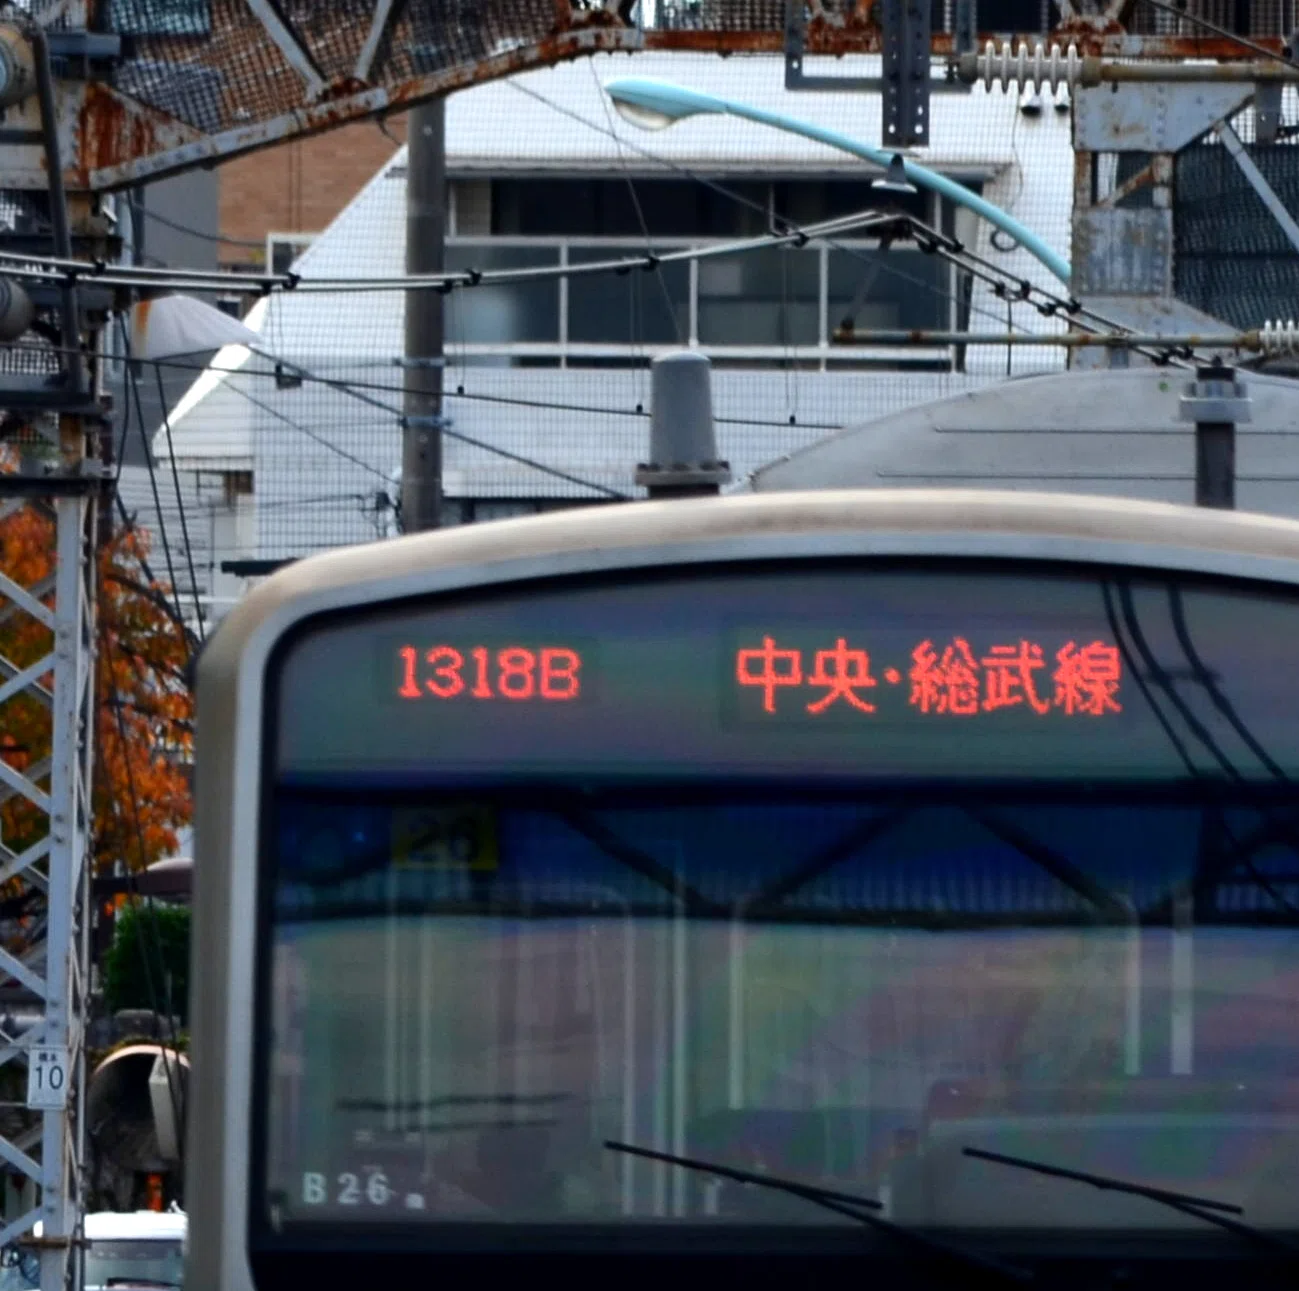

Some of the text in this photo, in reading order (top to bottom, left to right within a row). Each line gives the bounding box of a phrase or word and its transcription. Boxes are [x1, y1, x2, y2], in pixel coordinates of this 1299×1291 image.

[399, 645, 582, 700] 1318B
[735, 637, 1124, 715] 中央・総武線
[35, 1065, 64, 1090] 10
